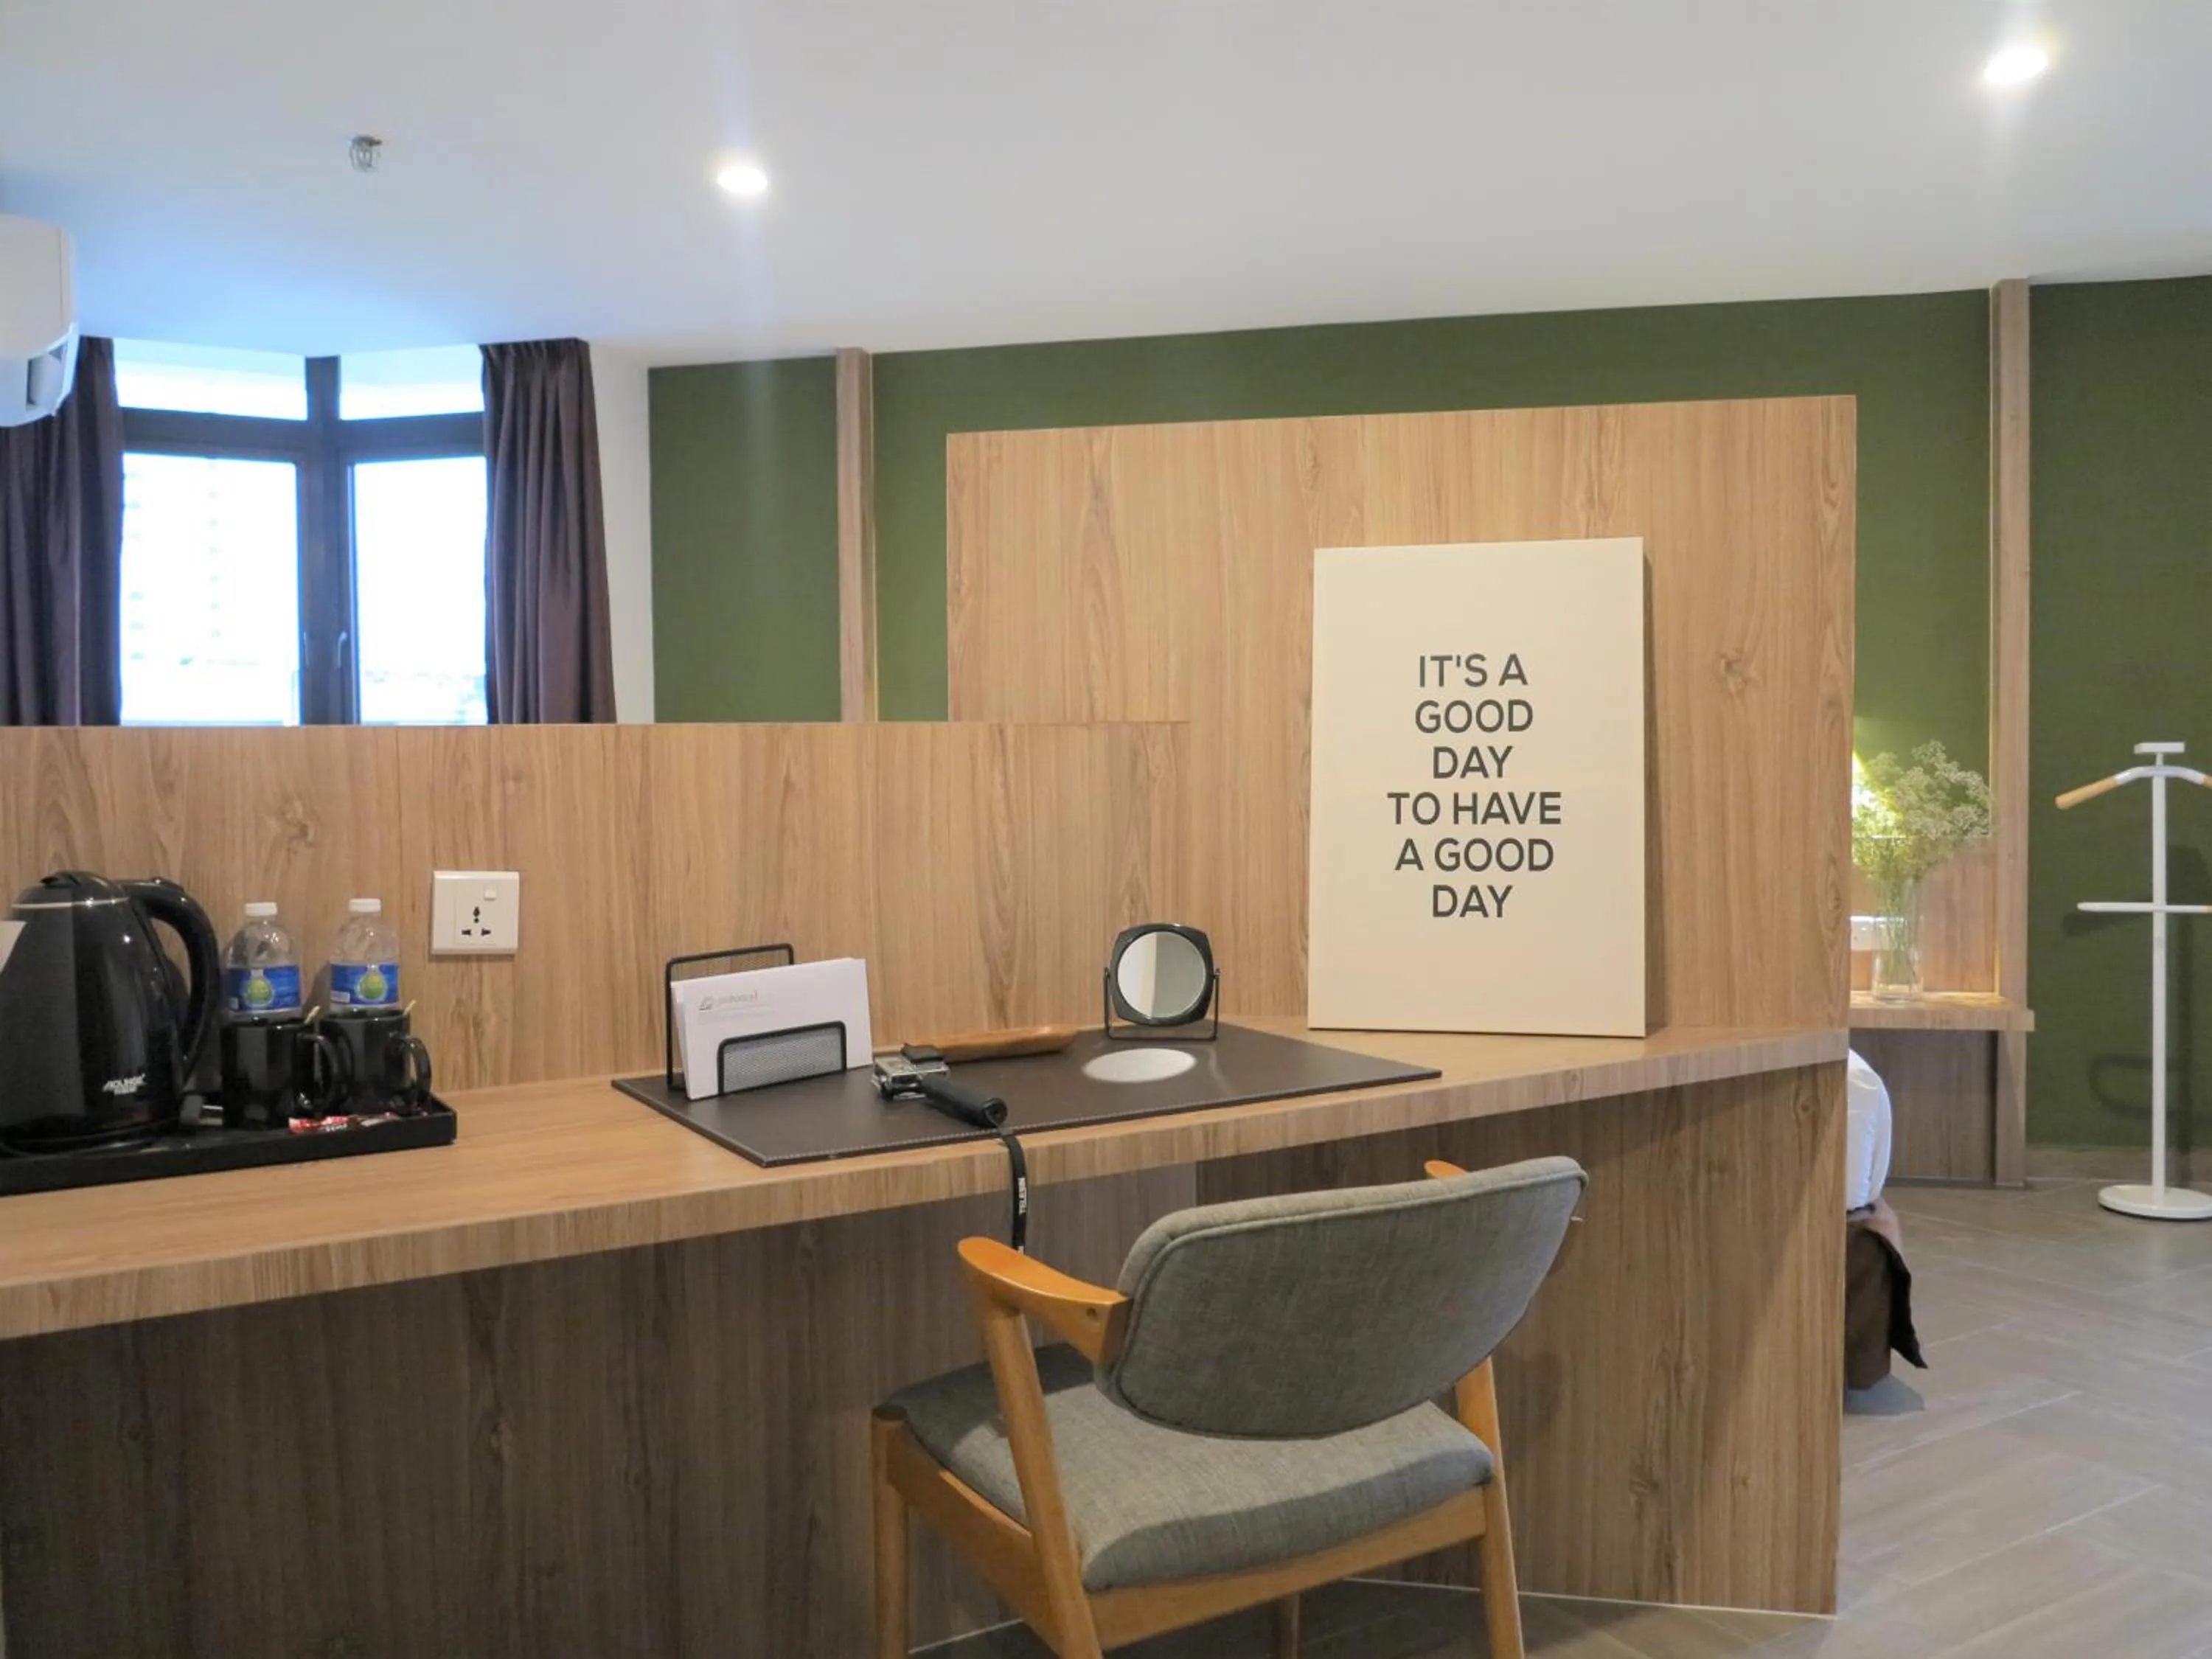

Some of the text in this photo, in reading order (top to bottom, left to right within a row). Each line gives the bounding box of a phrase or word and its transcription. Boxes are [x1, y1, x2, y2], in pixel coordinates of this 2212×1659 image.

[1419, 653, 1528, 687] IT'S A
[1415, 699, 1533, 733] GOOD
[1433, 745, 1513, 779] DAY
[1388, 791, 1562, 825] TO HAVE
[1394, 838, 1554, 872] A GOOD
[1433, 884, 1513, 918] DAY
